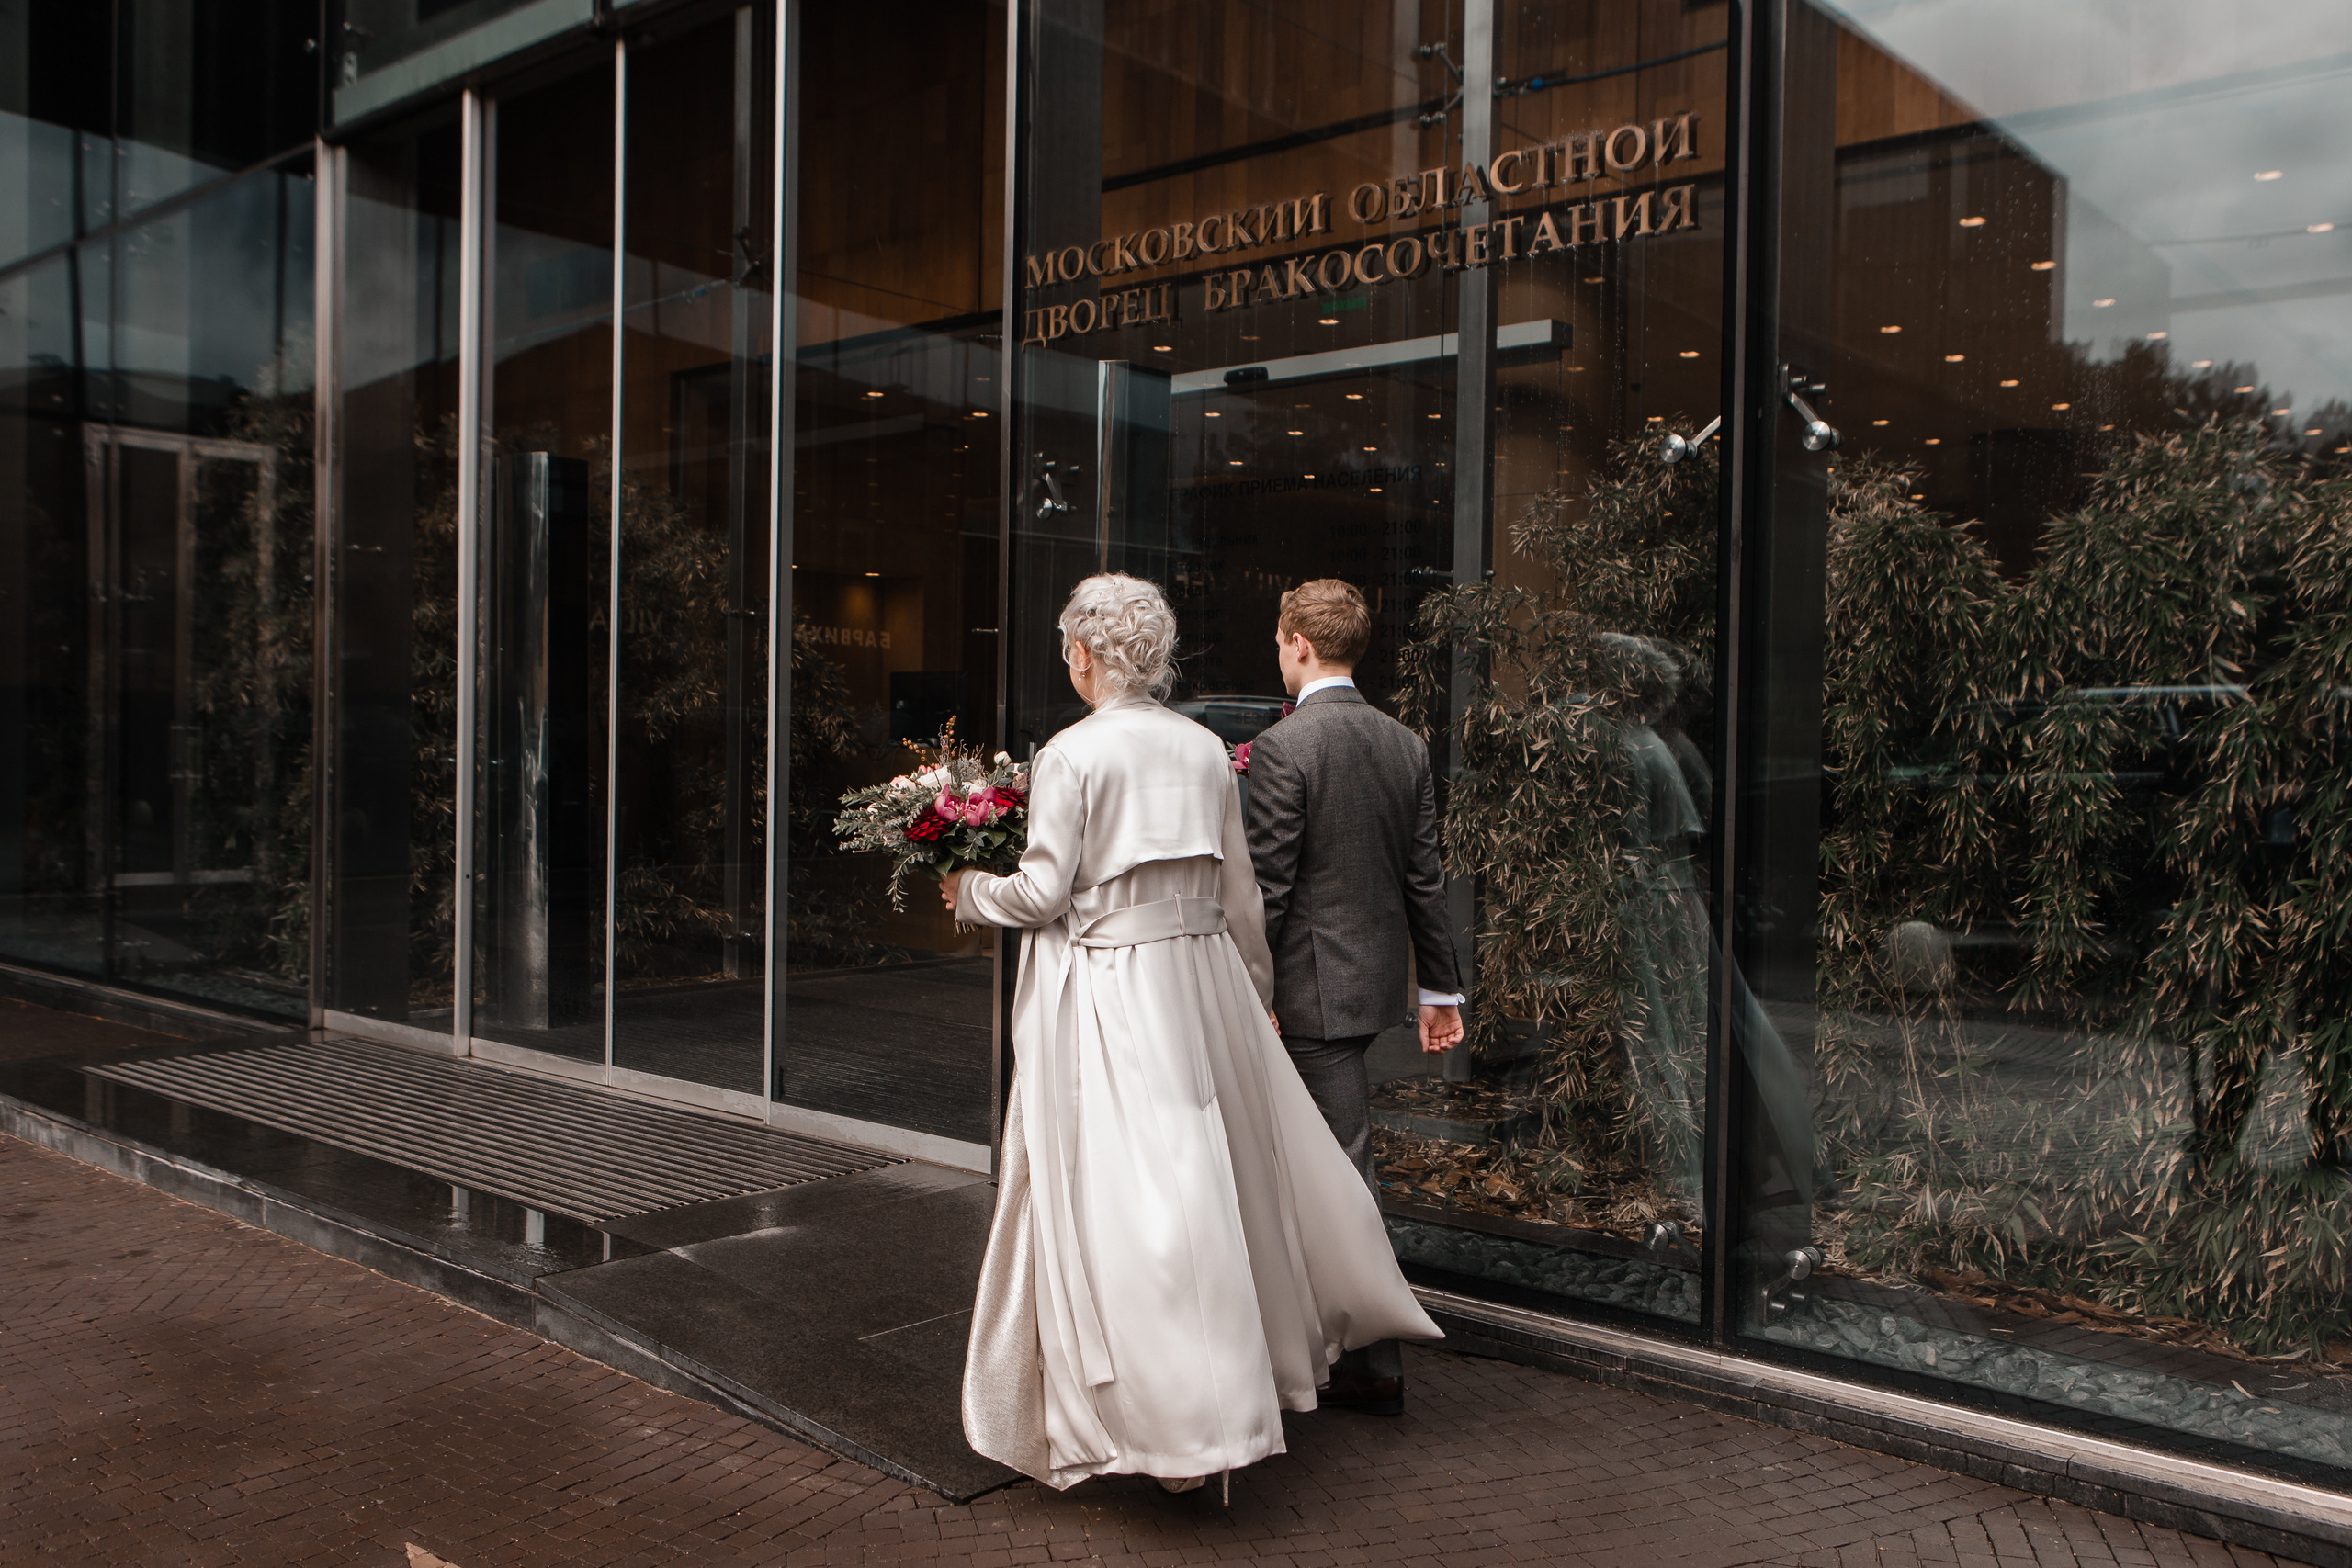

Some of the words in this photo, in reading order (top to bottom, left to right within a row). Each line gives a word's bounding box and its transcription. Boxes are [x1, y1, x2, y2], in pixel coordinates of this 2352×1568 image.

[1022, 282, 1172, 353] ДВОРЕЦ
[1203, 184, 1696, 311] БРАКОСОЧЕТАНИЯ
[1170, 482, 1234, 501] ГРАФИК
[1239, 476, 1308, 496] ПРИЕМА
[1314, 464, 1422, 490] НАСЕЛЕНИЯ
[1329, 523, 1368, 538] 10:00
[1381, 518, 1422, 536] 21:00
[1329, 547, 1367, 564] 10:00
[1381, 545, 1421, 561] 21:00
[1381, 570, 1420, 586] 21:00
[1380, 596, 1420, 613] 21:00
[1380, 622, 1420, 637] 21:00
[1379, 648, 1419, 663] 21:00
[1379, 674, 1419, 689] 21:00
